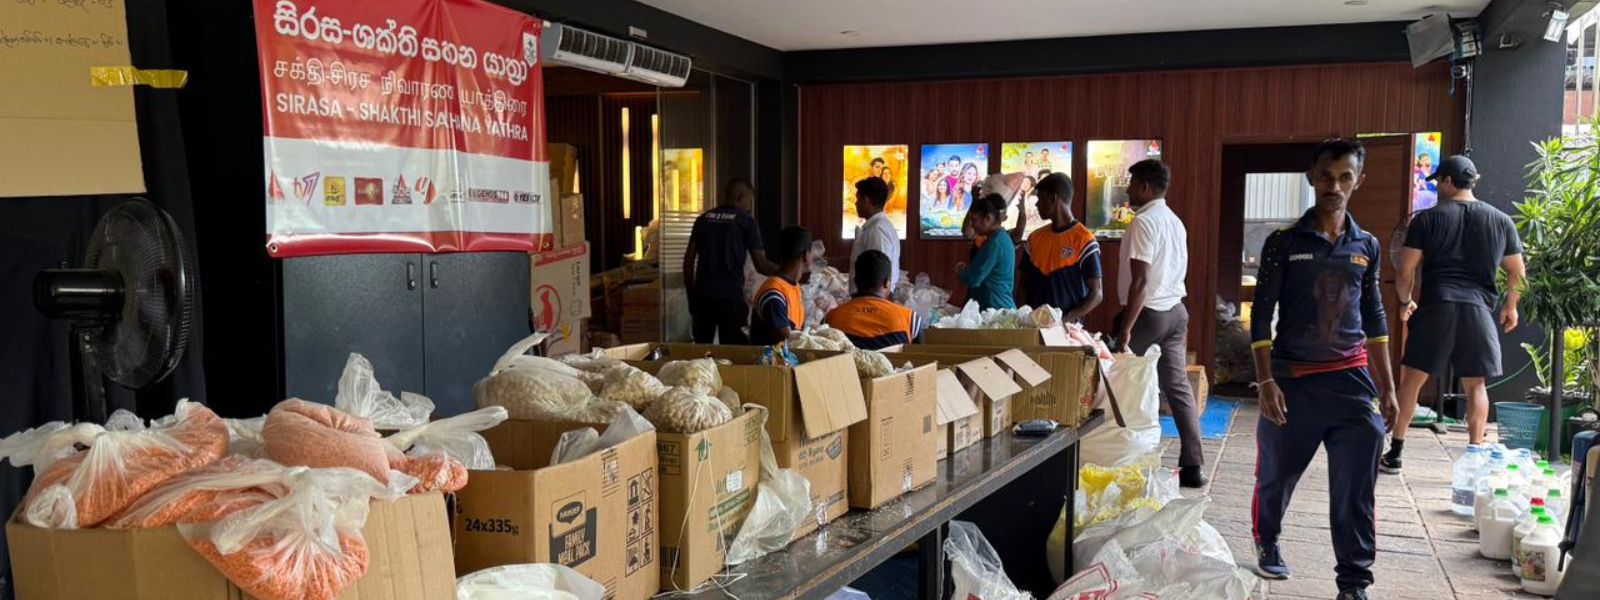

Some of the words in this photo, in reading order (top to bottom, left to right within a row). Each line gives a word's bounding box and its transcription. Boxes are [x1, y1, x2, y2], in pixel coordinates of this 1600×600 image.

[421, 37, 477, 69] සහන
[276, 93, 343, 118] SIRASA
[360, 102, 421, 127] SHAKTHI
[484, 117, 528, 141] YATHRA
[464, 517, 519, 535] 24x335g
